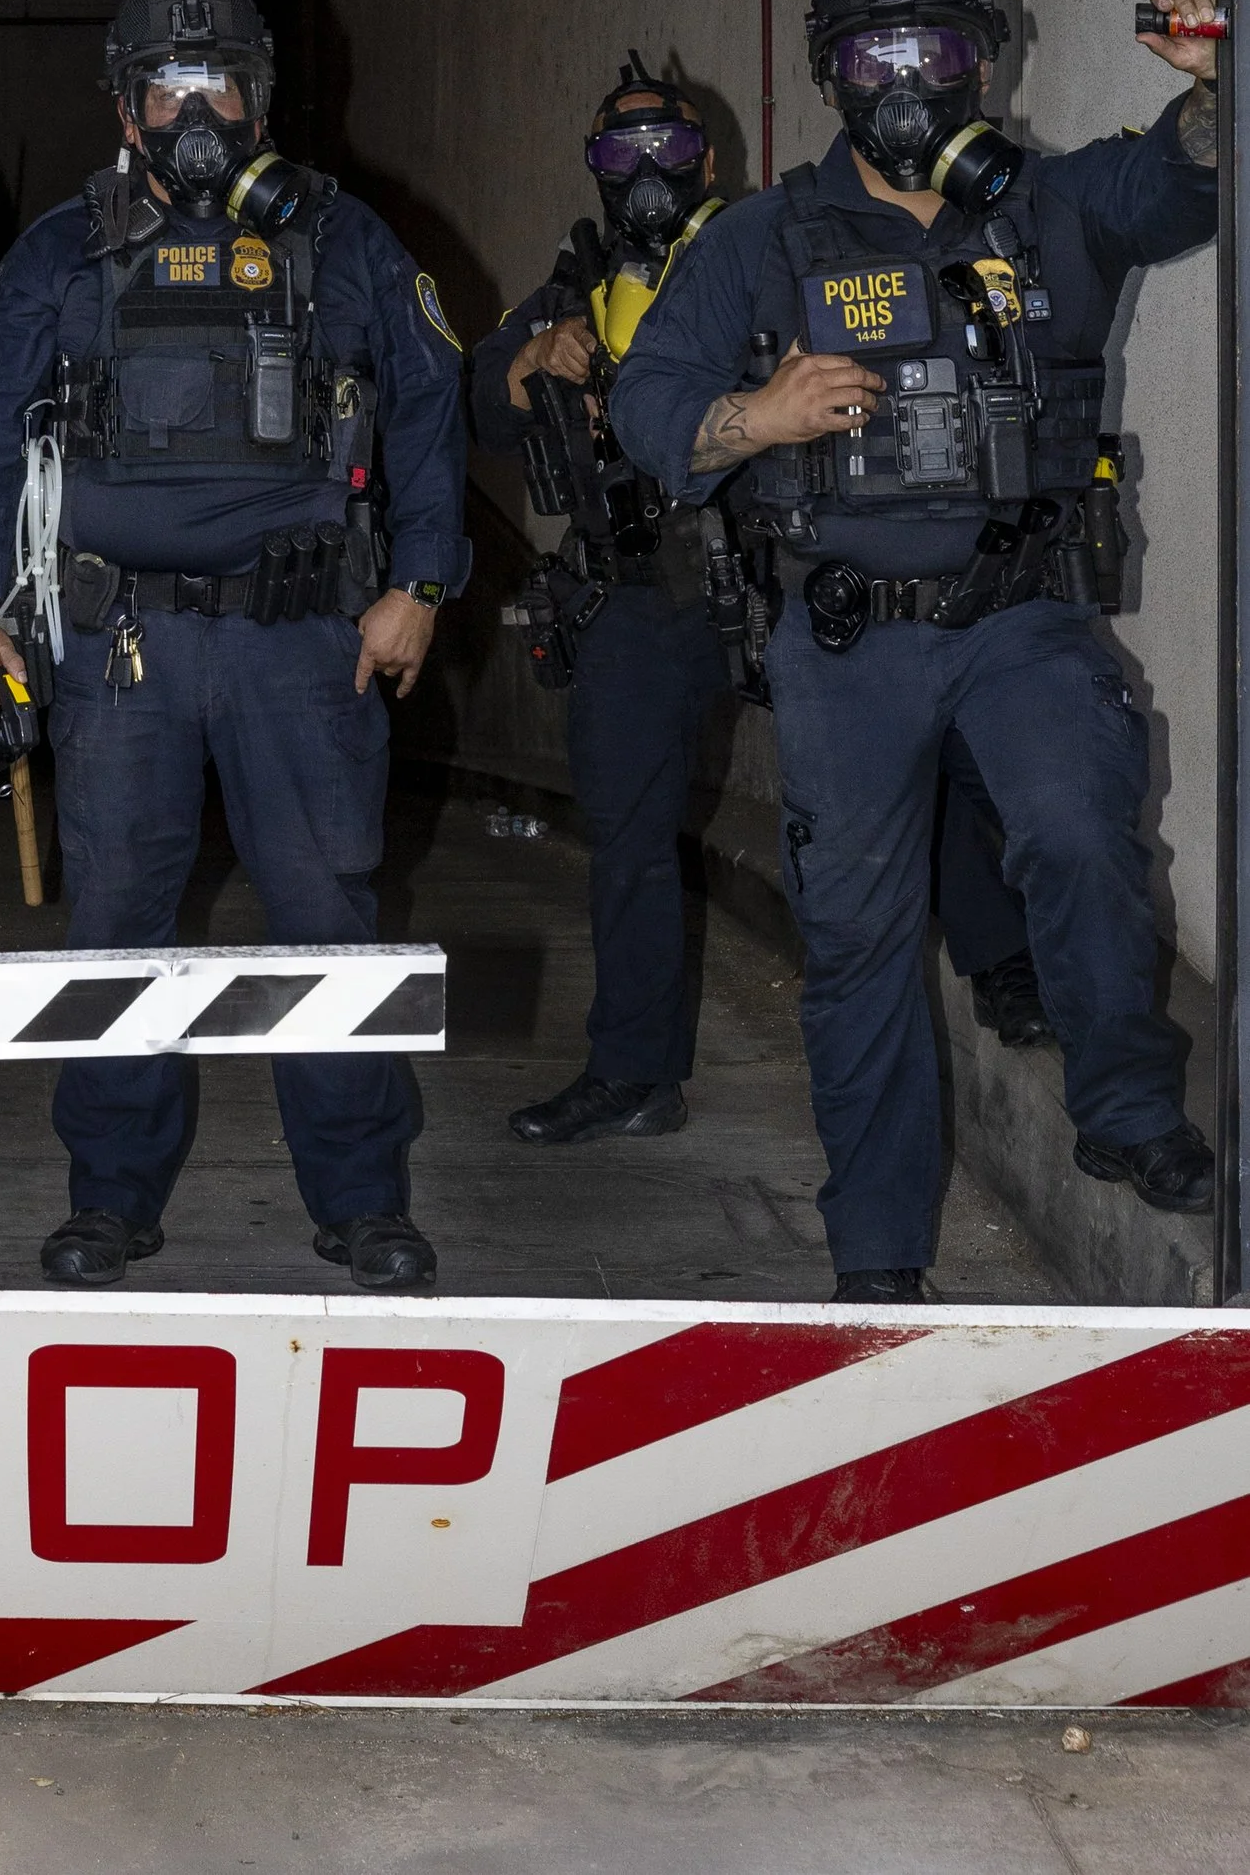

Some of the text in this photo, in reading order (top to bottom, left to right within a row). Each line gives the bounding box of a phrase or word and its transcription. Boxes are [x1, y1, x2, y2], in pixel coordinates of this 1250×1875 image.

[157, 246, 216, 263] POLICE
[240, 247, 264, 256] DHS
[169, 263, 205, 282] DHS
[824, 271, 907, 306] POLICE
[844, 300, 893, 329] DHS
[855, 329, 887, 342] 1445
